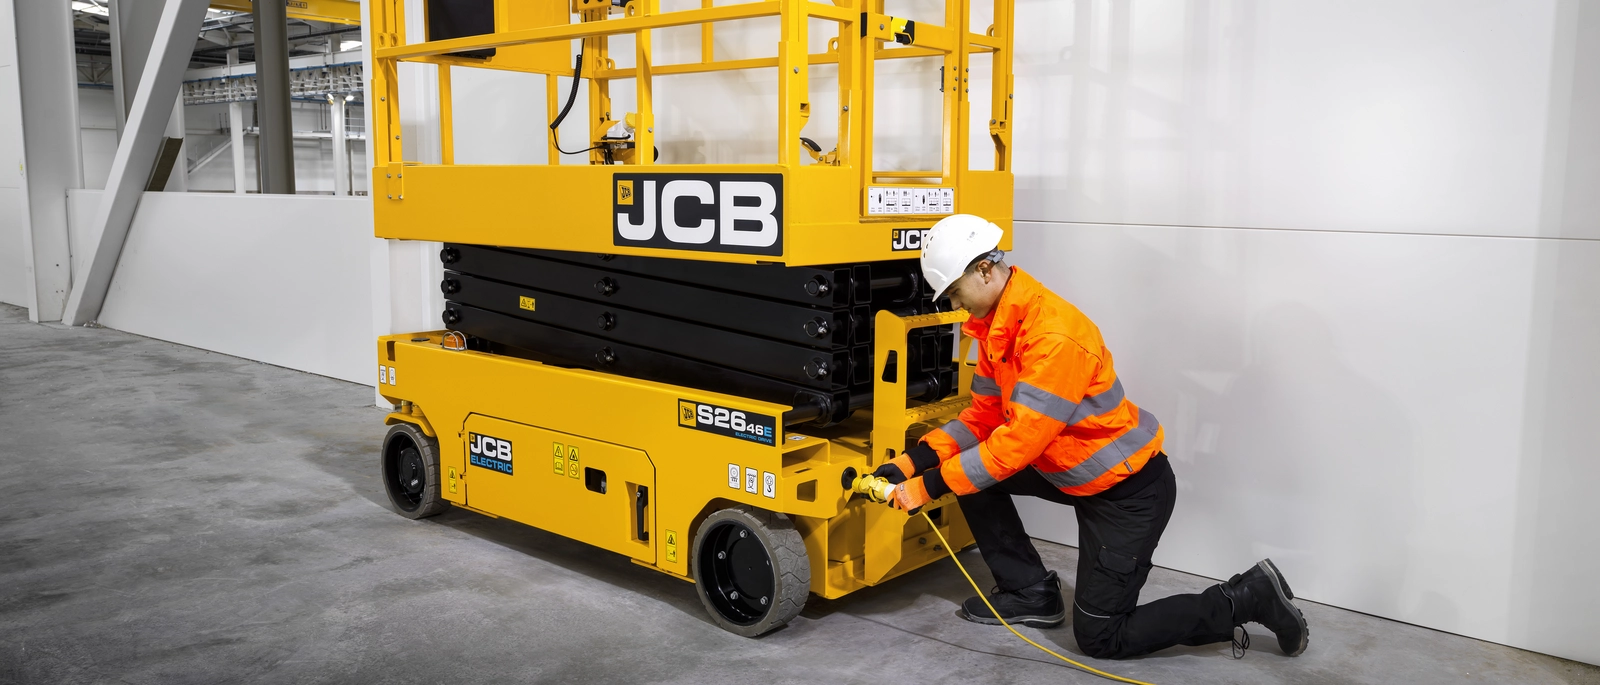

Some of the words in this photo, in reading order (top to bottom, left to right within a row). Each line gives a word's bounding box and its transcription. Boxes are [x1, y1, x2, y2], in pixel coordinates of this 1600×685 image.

[620, 185, 631, 199] JCB
[617, 180, 778, 247] JCB
[735, 431, 757, 440] ELECTRIC
[470, 435, 512, 461] JCB
[471, 455, 512, 473] ELECTRIC
